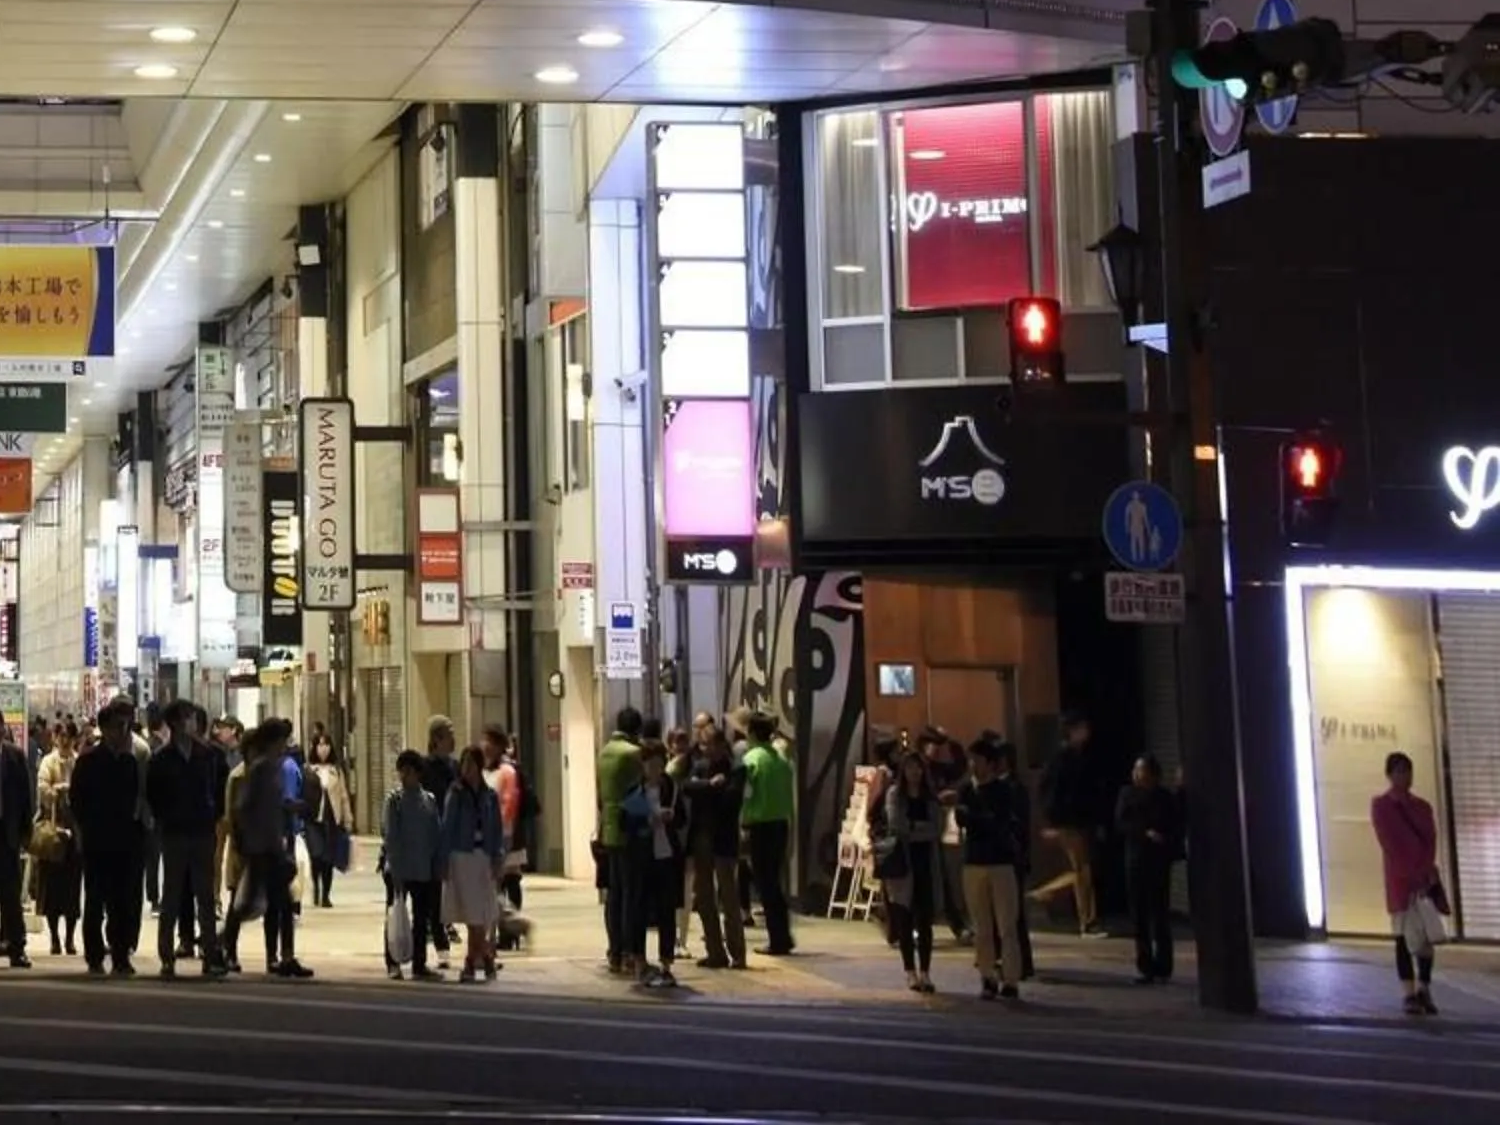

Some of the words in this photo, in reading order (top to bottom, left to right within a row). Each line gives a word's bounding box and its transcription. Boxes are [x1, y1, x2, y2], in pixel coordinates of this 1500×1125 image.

[318, 407, 336, 511] MARUTA
[319, 518, 337, 558] GO
[318, 584, 340, 602] 2F
